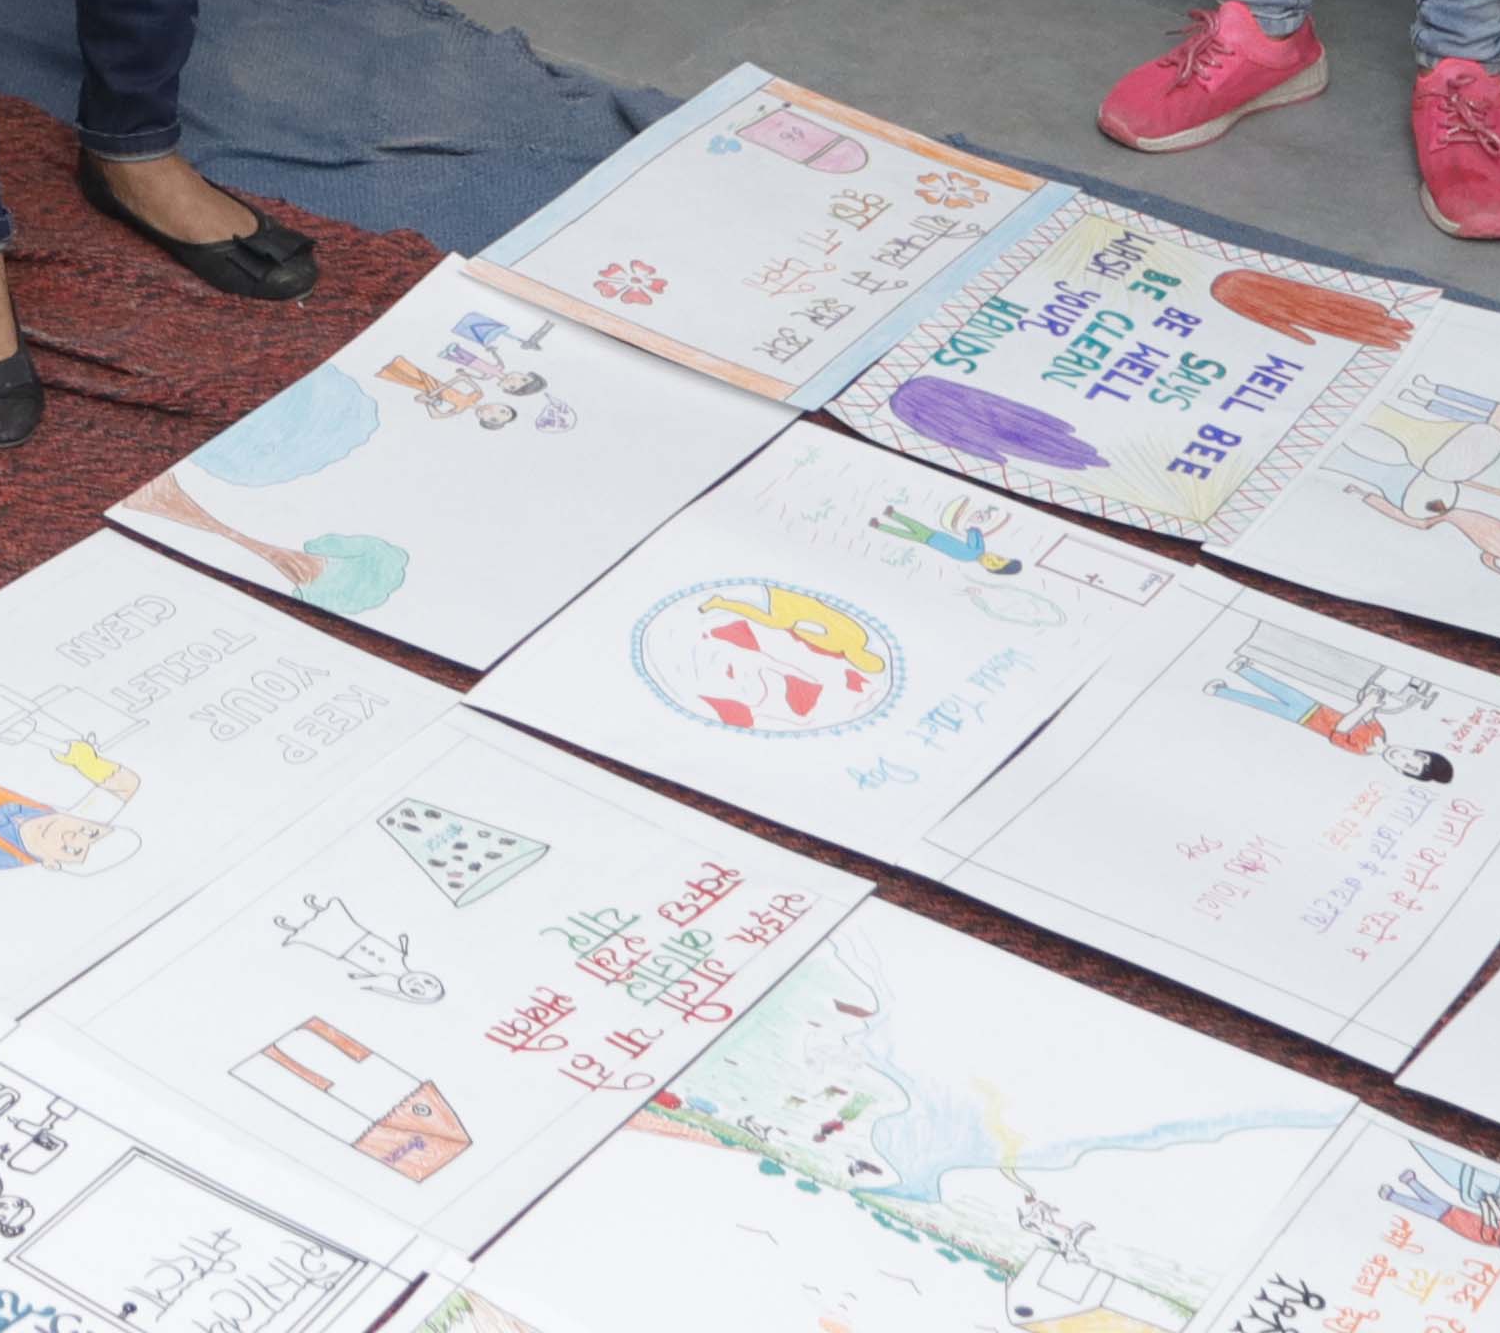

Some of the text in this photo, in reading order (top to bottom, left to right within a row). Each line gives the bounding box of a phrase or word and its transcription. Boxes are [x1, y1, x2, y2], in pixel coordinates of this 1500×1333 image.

[1085, 229, 1156, 284] WASH
[931, 294, 1030, 375] HANDS
[1041, 267, 1184, 389] BE CLEAN
[1084, 303, 1204, 404] BE WELL
[1164, 351, 1307, 482] WELL BEE
[55, 593, 178, 669] CLEAN
[103, 627, 258, 714] TOILET
[188, 655, 332, 743] YOUR
[281, 682, 391, 767] KEEP
